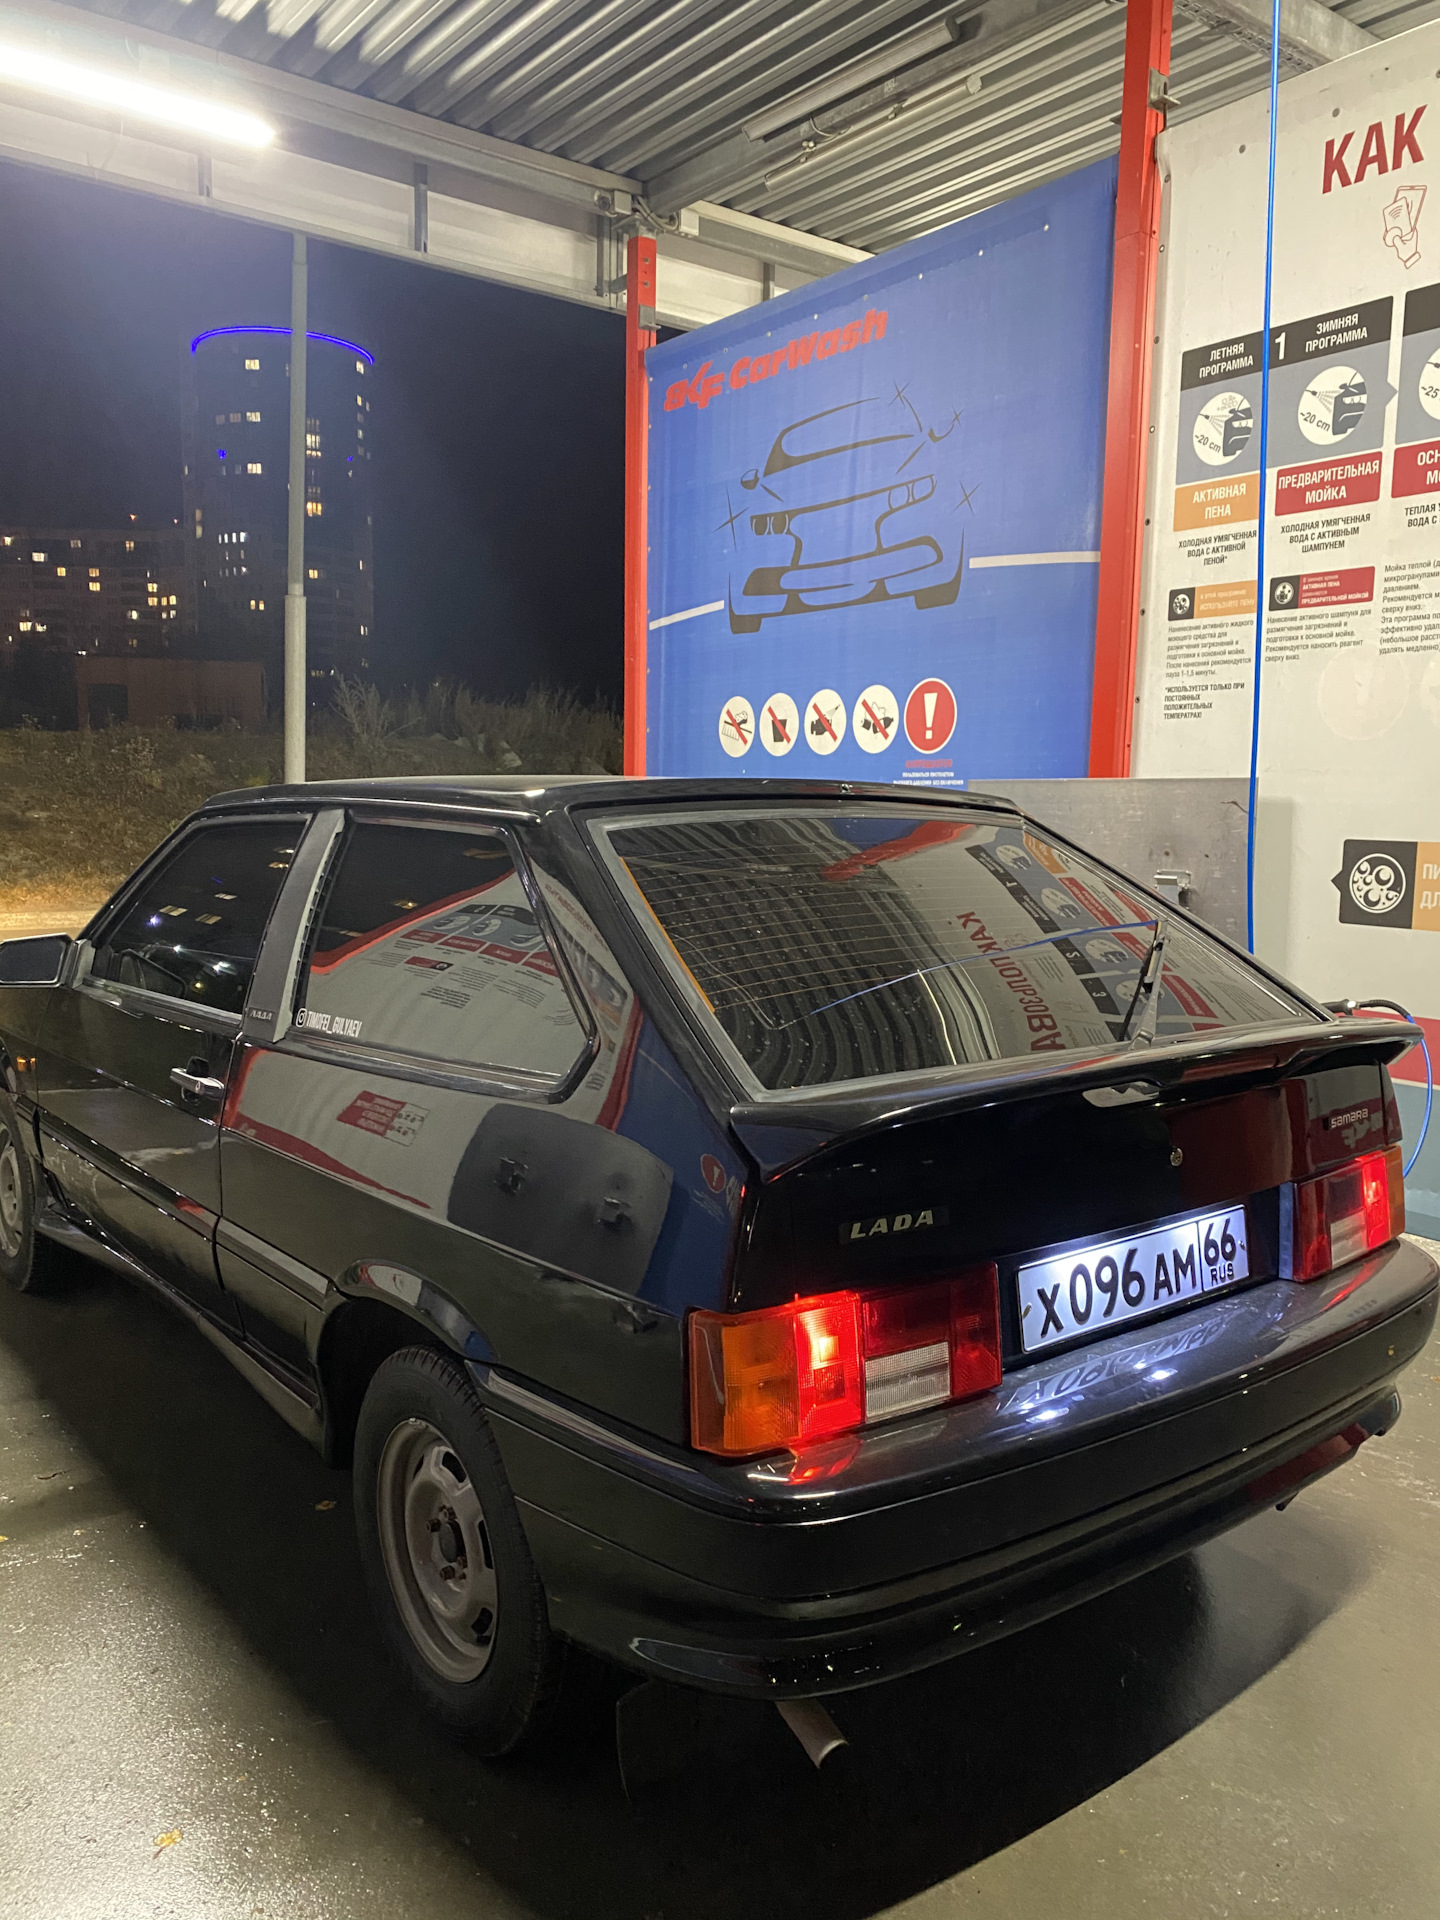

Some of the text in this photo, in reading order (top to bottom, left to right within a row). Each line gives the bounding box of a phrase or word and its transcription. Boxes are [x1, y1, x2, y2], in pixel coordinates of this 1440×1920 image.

[1322, 104, 1428, 194] КАК
[1316, 313, 1358, 334] ЗИМНЯЯ
[1275, 332, 1286, 360] 1
[1305, 327, 1368, 352] ПРОГРАММА
[729, 308, 889, 390] CarWash
[1210, 343, 1244, 361] ЛЕТНЯЯ
[1199, 355, 1253, 378] ПРОГРАММА
[1316, 420, 1330, 431] cm
[1278, 460, 1379, 489] ПРЕДВАРИТЕЛЬНАЯ
[1426, 470, 1440, 485] М
[1193, 483, 1246, 503] АКТИВНАЯ
[1305, 485, 1347, 504] МОЙКА
[1205, 504, 1231, 519] ПЕНА
[1404, 503, 1436, 516] ТЕПЛАЯ
[1281, 513, 1371, 534] ХОЛОДНАЯ УМЯГЧЕННАЯ
[1407, 515, 1438, 528] ВОДА С
[1178, 530, 1257, 549] ХОЛОДНАЯ УМЯГЧЕННАЯ
[1289, 527, 1360, 544] ВОДА С АКТИВНЫМ
[1187, 541, 1246, 558] ВОДА С АКТИВНОЙ
[1302, 540, 1345, 553] ШАМПУНЕМ
[1384, 564, 1406, 572] Мойка
[1408, 560, 1431, 570] теплой
[1382, 592, 1433, 603] Рекомендуется
[1381, 616, 1393, 624] Эта
[1394, 613, 1430, 623] программа
[1380, 624, 1423, 634] эффективно
[1379, 646, 1405, 656] удалять
[1210, 683, 1232, 691] ТОЛЬКО
[1233, 682, 1245, 690] ПРИ
[1164, 702, 1213, 711] ПОЛОЖИТЕЛЬНЫХ
[850, 1210, 934, 1239] LADA
[1204, 1218, 1236, 1267] 66
[1209, 1261, 1235, 1287] RUS
